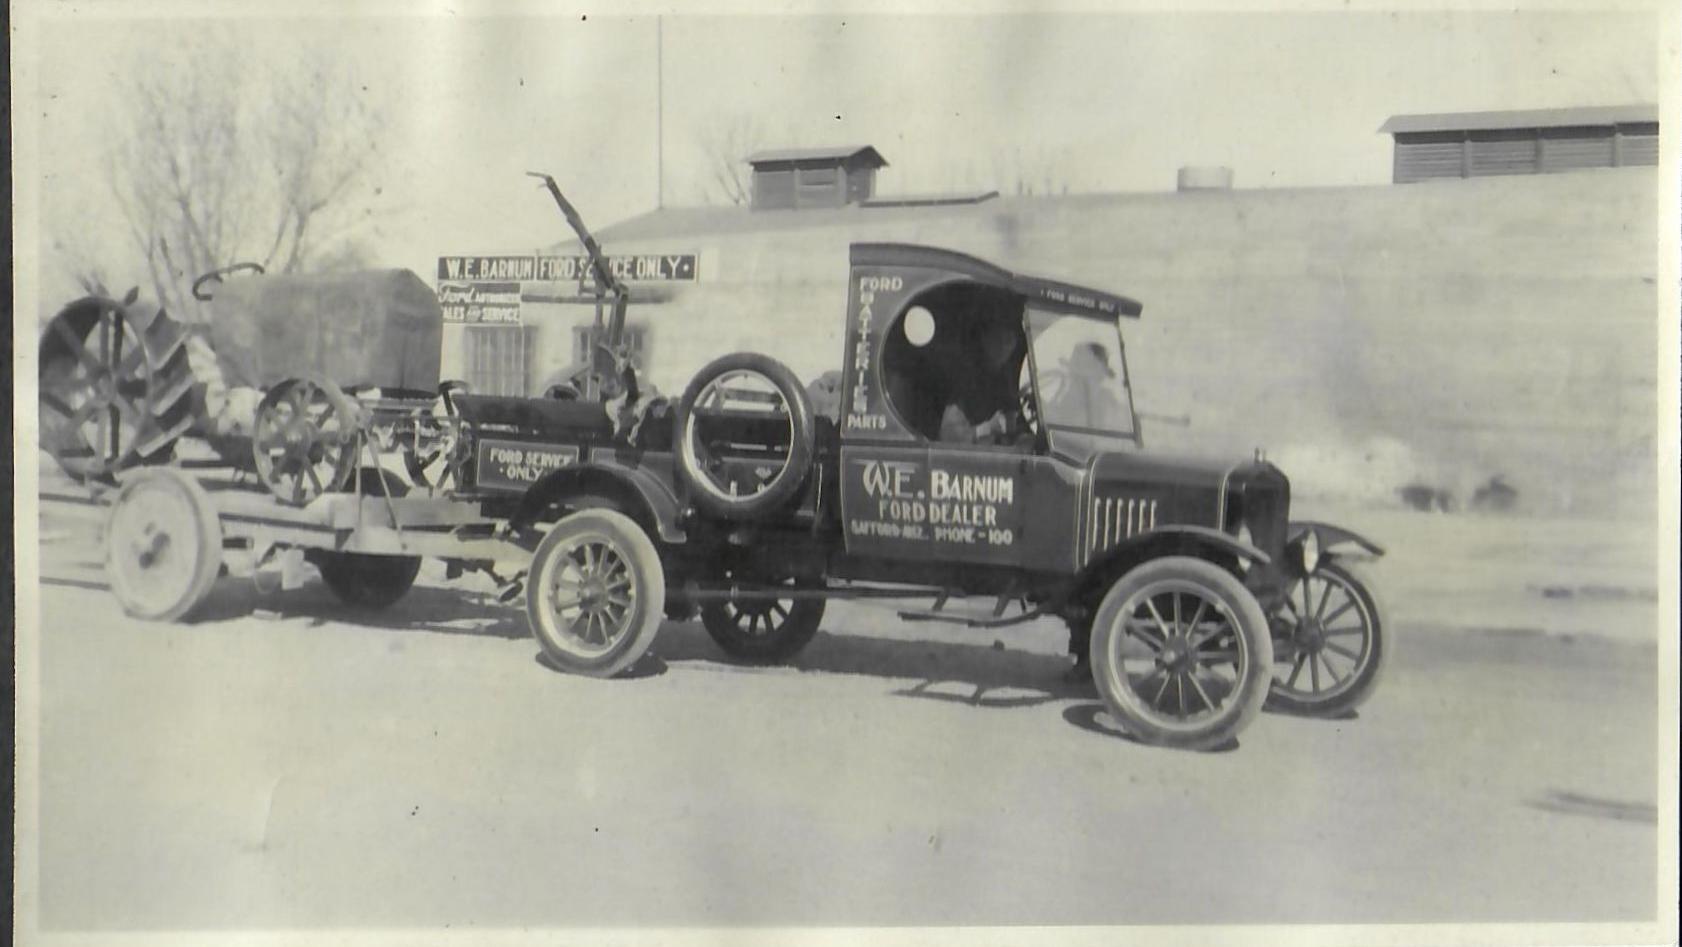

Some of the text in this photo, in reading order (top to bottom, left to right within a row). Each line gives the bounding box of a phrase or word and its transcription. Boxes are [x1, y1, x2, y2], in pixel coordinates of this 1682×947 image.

[480, 258, 533, 279] BARNUM
[540, 257, 576, 278] FORD
[636, 256, 682, 279] ONLY
[438, 281, 475, 303] Ford
[860, 277, 903, 291] FORD
[848, 414, 886, 429] PARTS
[490, 448, 523, 464] FORD
[506, 465, 543, 481] ONLY
[930, 469, 1014, 504] BARNUM
[879, 499, 997, 527] FORD DEALER
